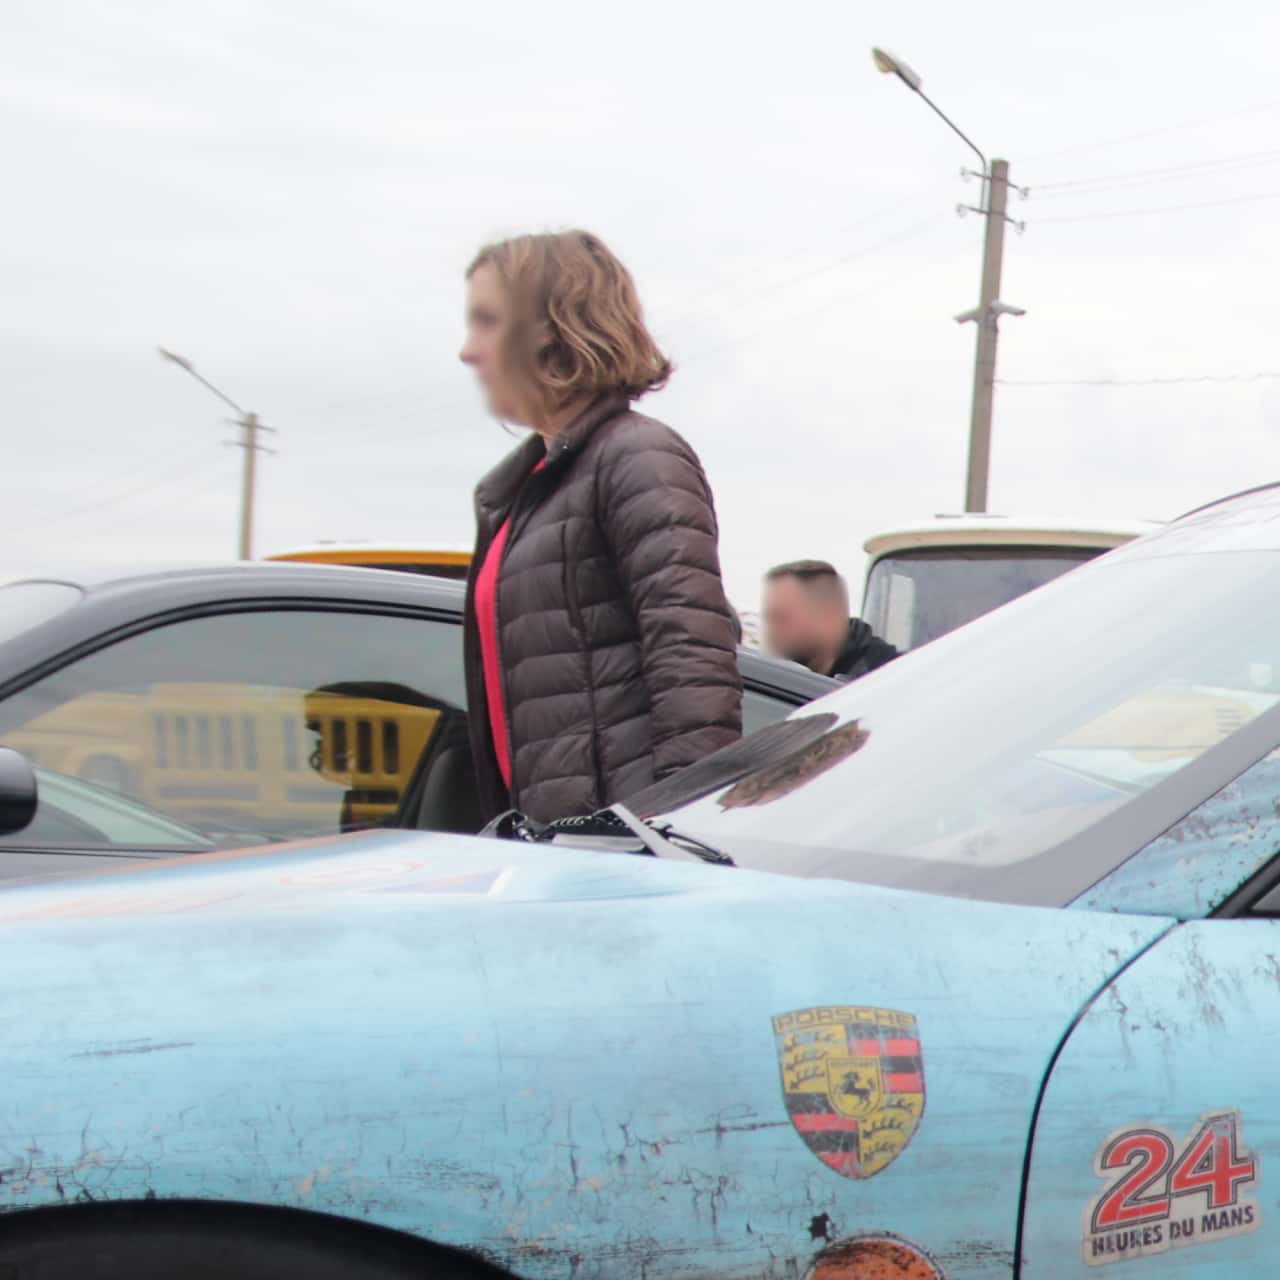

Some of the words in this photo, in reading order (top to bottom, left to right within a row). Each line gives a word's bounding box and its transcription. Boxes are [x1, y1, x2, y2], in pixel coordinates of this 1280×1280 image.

[774, 1007, 916, 1033] PORSCHE
[1090, 1111, 1255, 1235] 24
[1091, 1225, 1163, 1257] HEURES
[1169, 1217, 1195, 1240] DU
[1201, 1205, 1254, 1234] MANS
